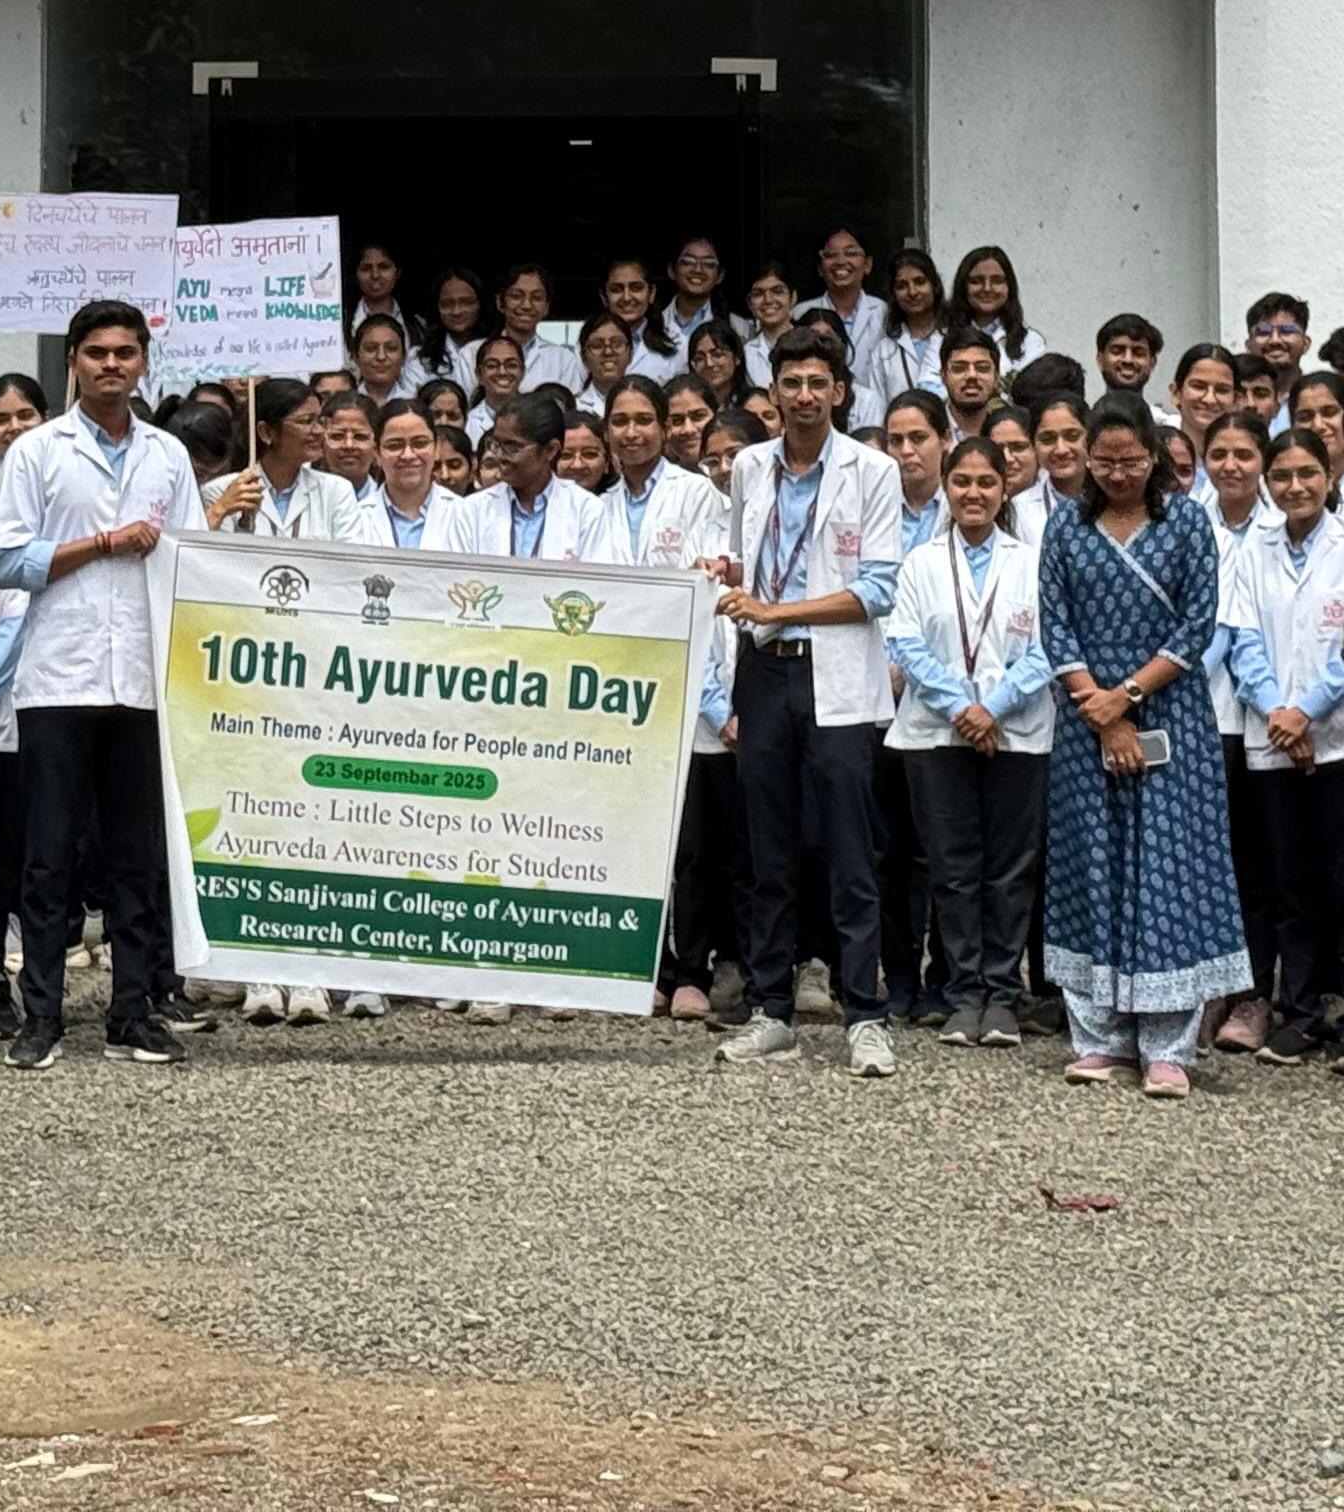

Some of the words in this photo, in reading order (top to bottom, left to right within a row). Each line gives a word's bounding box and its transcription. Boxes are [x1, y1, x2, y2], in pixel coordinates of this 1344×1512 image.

[177, 277, 211, 300] AYU
[264, 275, 305, 298] LIFE
[175, 303, 219, 323] VEDA
[200, 634, 307, 689] 10th
[324, 645, 548, 708] Ayurveda
[568, 665, 658, 726] Day
[211, 712, 254, 736] Main
[261, 716, 322, 741] Theme
[338, 723, 427, 749] Ayurveda
[432, 730, 459, 752] for
[464, 732, 527, 761] People
[533, 740, 568, 761] and
[573, 741, 633, 766] Planet
[313, 760, 337, 779] 23
[443, 771, 486, 791] 2025
[226, 789, 306, 819] Theme
[329, 799, 392, 826] Little
[399, 804, 462, 836] Steps
[471, 813, 493, 834] to
[501, 812, 605, 843] Wellness
[215, 830, 327, 860] Ayurveda
[333, 840, 458, 871] Awareness
[467, 849, 501, 874] for
[507, 853, 608, 883] Students
[268, 881, 377, 911] Sanjivani
[383, 890, 468, 922] College
[474, 898, 501, 920] of
[501, 900, 612, 929] Ayurveda
[618, 908, 640, 931] &
[240, 914, 344, 943] Research
[350, 924, 433, 953] Center,
[440, 931, 569, 963] Kopargaon
